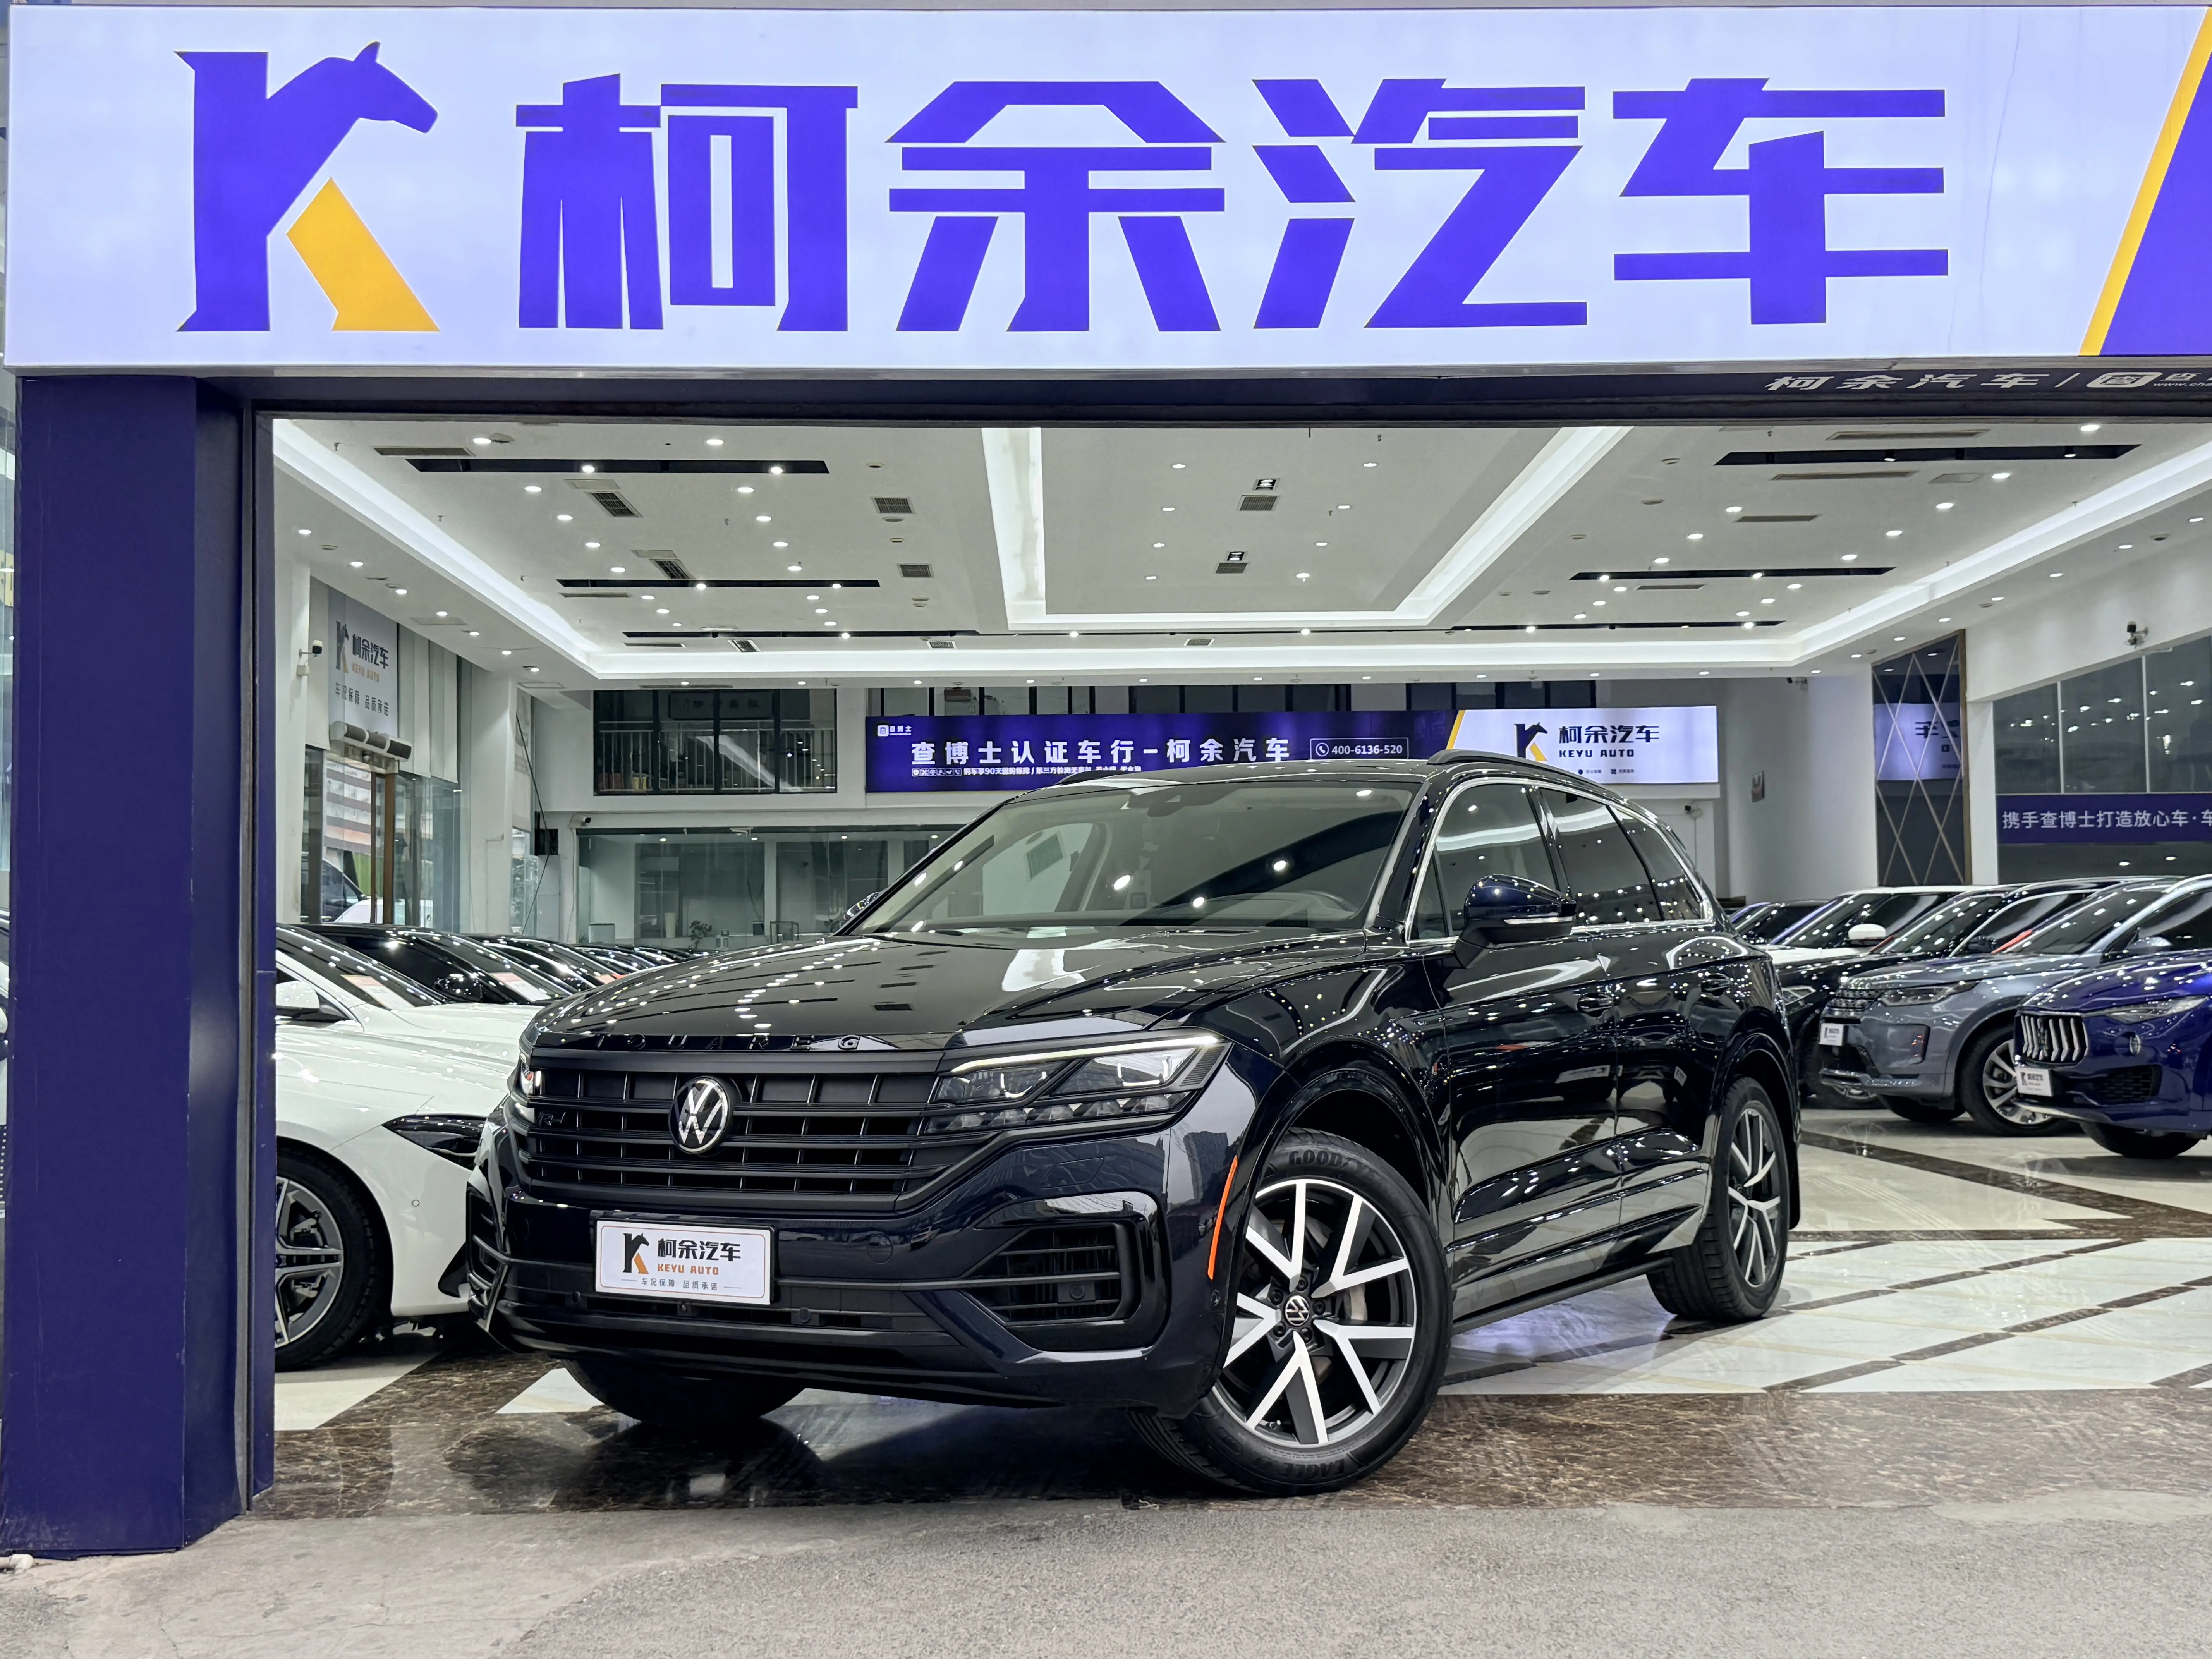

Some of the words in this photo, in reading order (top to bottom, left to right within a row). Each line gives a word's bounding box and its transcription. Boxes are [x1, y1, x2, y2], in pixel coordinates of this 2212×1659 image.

[516, 73, 1949, 332] 柯余汽车
[1765, 373, 2050, 391] 柯余汽车
[352, 634, 389, 669] 柯余汽车
[1559, 725, 1660, 744] 柯余汽车
[1331, 744, 1403, 756] 400-6136-520
[1559, 749, 1592, 758] KEYU
[1600, 749, 1635, 758] AUTO
[598, 1034, 861, 1051] TOUAREG
[658, 1238, 741, 1262] 柯余汽车
[658, 1263, 685, 1273] KEYU
[690, 1264, 719, 1275] AUTO
[641, 1278, 675, 1288] 车况保障
[682, 1280, 718, 1291] 品质承诺
